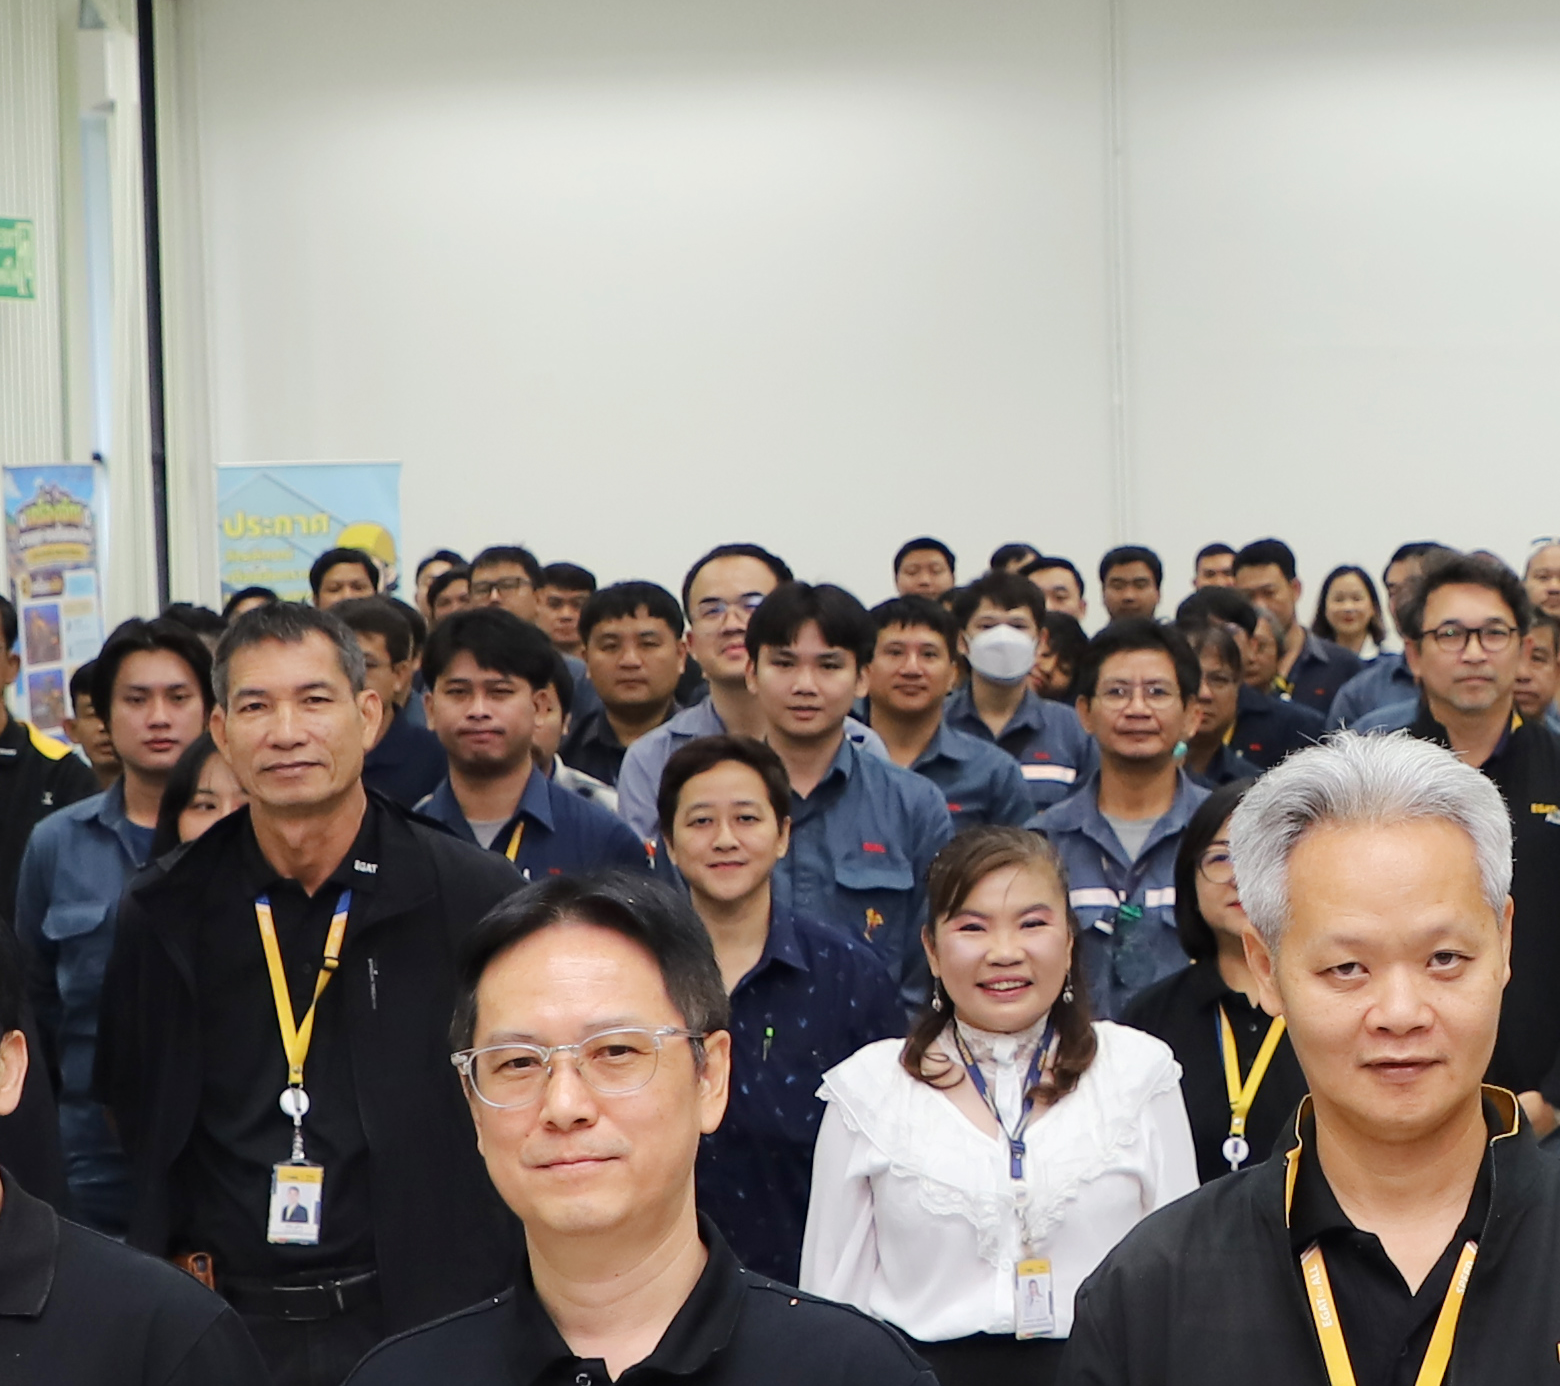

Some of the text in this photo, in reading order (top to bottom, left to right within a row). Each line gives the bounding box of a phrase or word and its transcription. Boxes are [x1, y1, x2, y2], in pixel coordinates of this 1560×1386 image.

[223, 510, 330, 539] ประกาศ
[1308, 1263, 1322, 1286] ALL
[1316, 1299, 1333, 1328] EGAT
